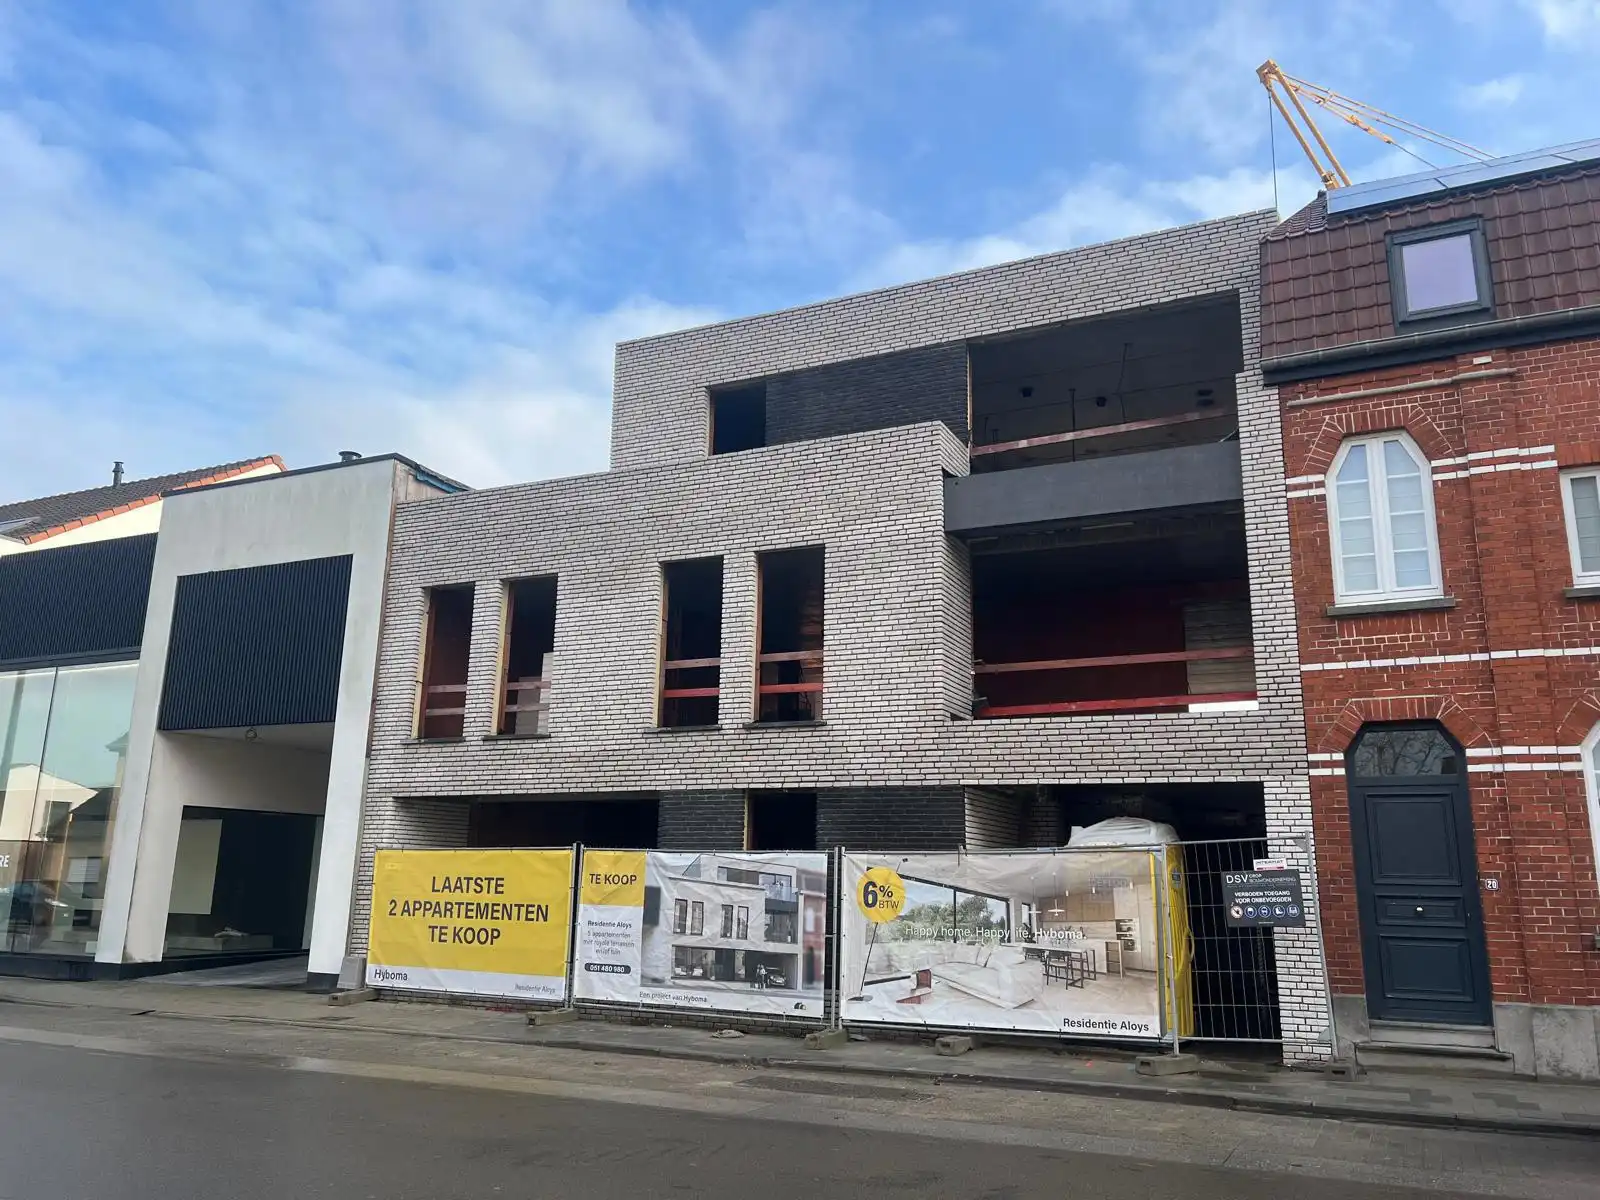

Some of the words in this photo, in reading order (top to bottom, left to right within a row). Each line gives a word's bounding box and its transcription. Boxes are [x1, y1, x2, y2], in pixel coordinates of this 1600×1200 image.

[431, 876, 505, 895] LAATSTE
[589, 873, 601, 884] TE
[604, 874, 637, 885] KOOP
[1226, 875, 1248, 884] DSV
[1487, 880, 1497, 889] 20
[388, 899, 398, 916] 2
[401, 900, 549, 922] APPARTEMENTEN
[879, 900, 900, 909] BTW
[428, 925, 448, 943] TE
[453, 927, 501, 945] KOOP
[905, 926, 938, 938] Happy
[941, 926, 973, 937] home.
[975, 927, 1011, 941] Happy
[1034, 928, 1087, 941] Hyboma.
[374, 969, 408, 983] Hyboma
[683, 994, 708, 1003] Hyboma
[1063, 1018, 1118, 1031] Residentie
[1120, 1021, 1149, 1034] Aloys
